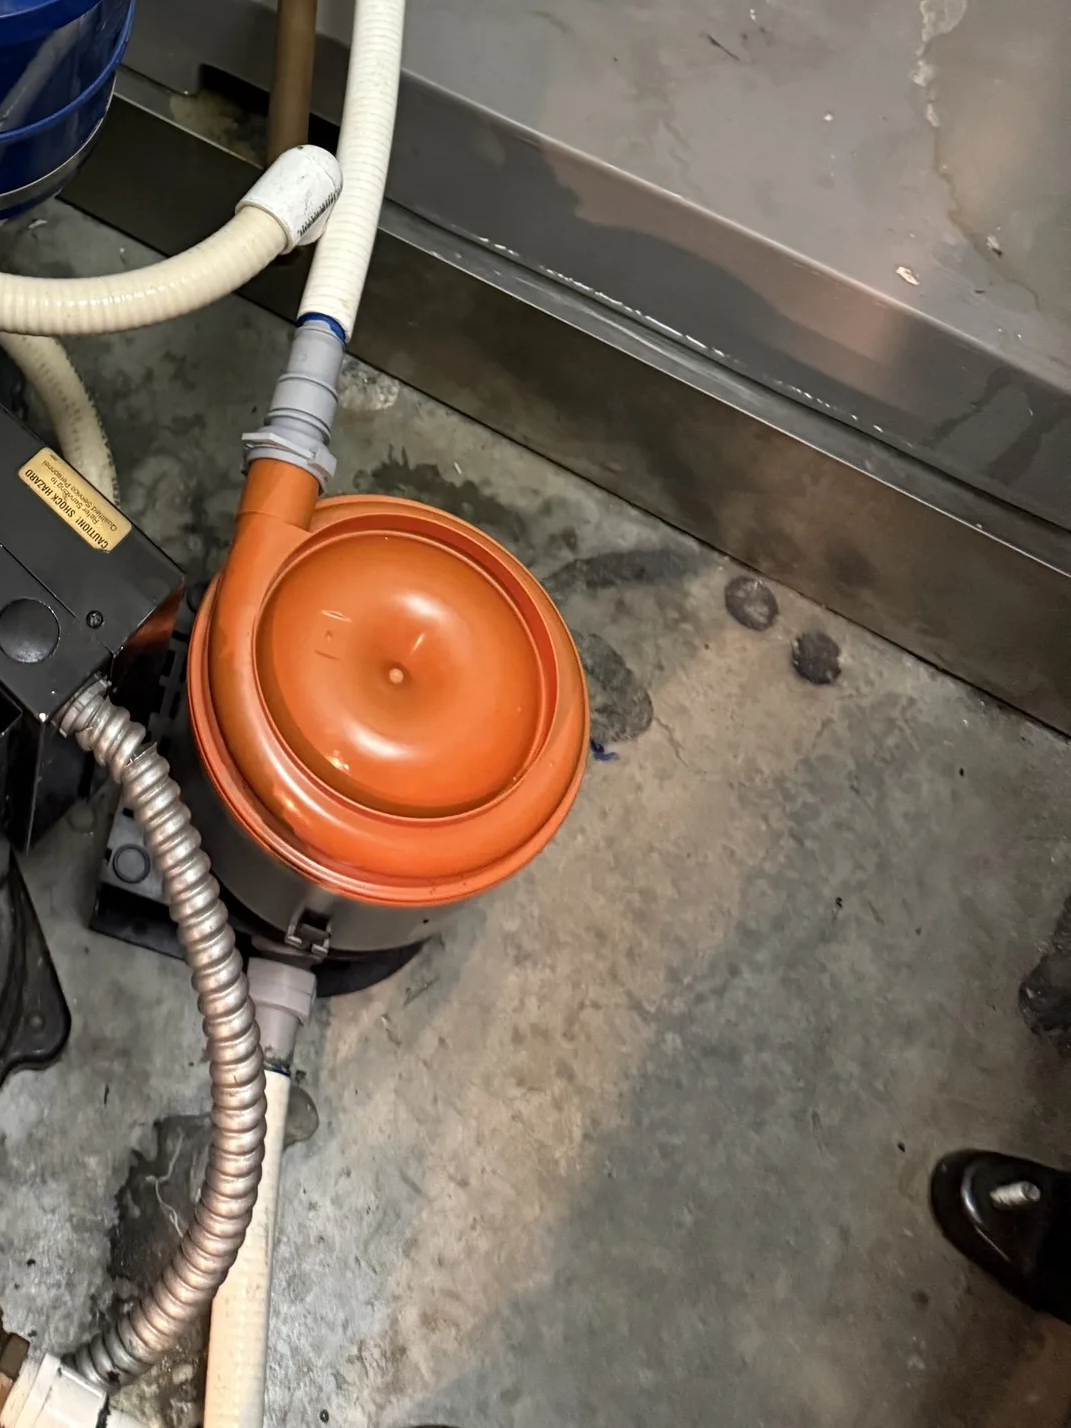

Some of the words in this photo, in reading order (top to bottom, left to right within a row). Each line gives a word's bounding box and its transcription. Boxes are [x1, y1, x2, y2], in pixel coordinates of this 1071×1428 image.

[25, 469, 53, 496] HAZARD
[42, 460, 70, 488] Personnel
[50, 477, 57, 485] to
[51, 493, 76, 518] SHOCK
[57, 484, 82, 509] Servicing
[70, 485, 92, 506] Service
[83, 507, 98, 524] Refer
[90, 504, 117, 531] Qualified
[75, 516, 108, 549] CAUTION!
